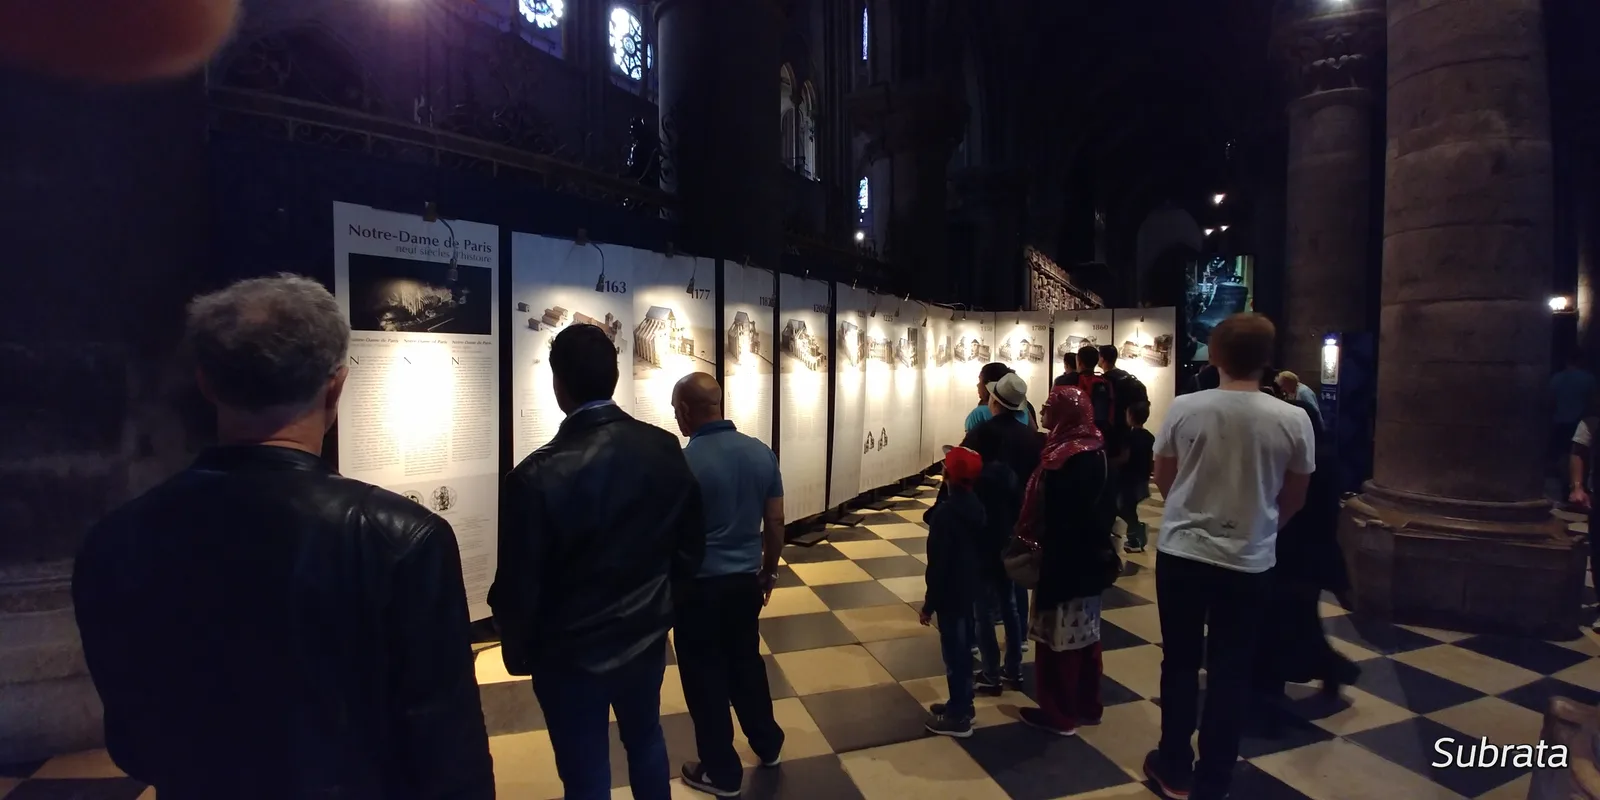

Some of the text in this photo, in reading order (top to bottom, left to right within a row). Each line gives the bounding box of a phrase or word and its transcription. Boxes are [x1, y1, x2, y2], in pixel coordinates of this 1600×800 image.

[348, 223, 492, 253] Notre-Dame de Paris
[396, 245, 417, 254] neuf
[1092, 324, 1109, 332] 1860
